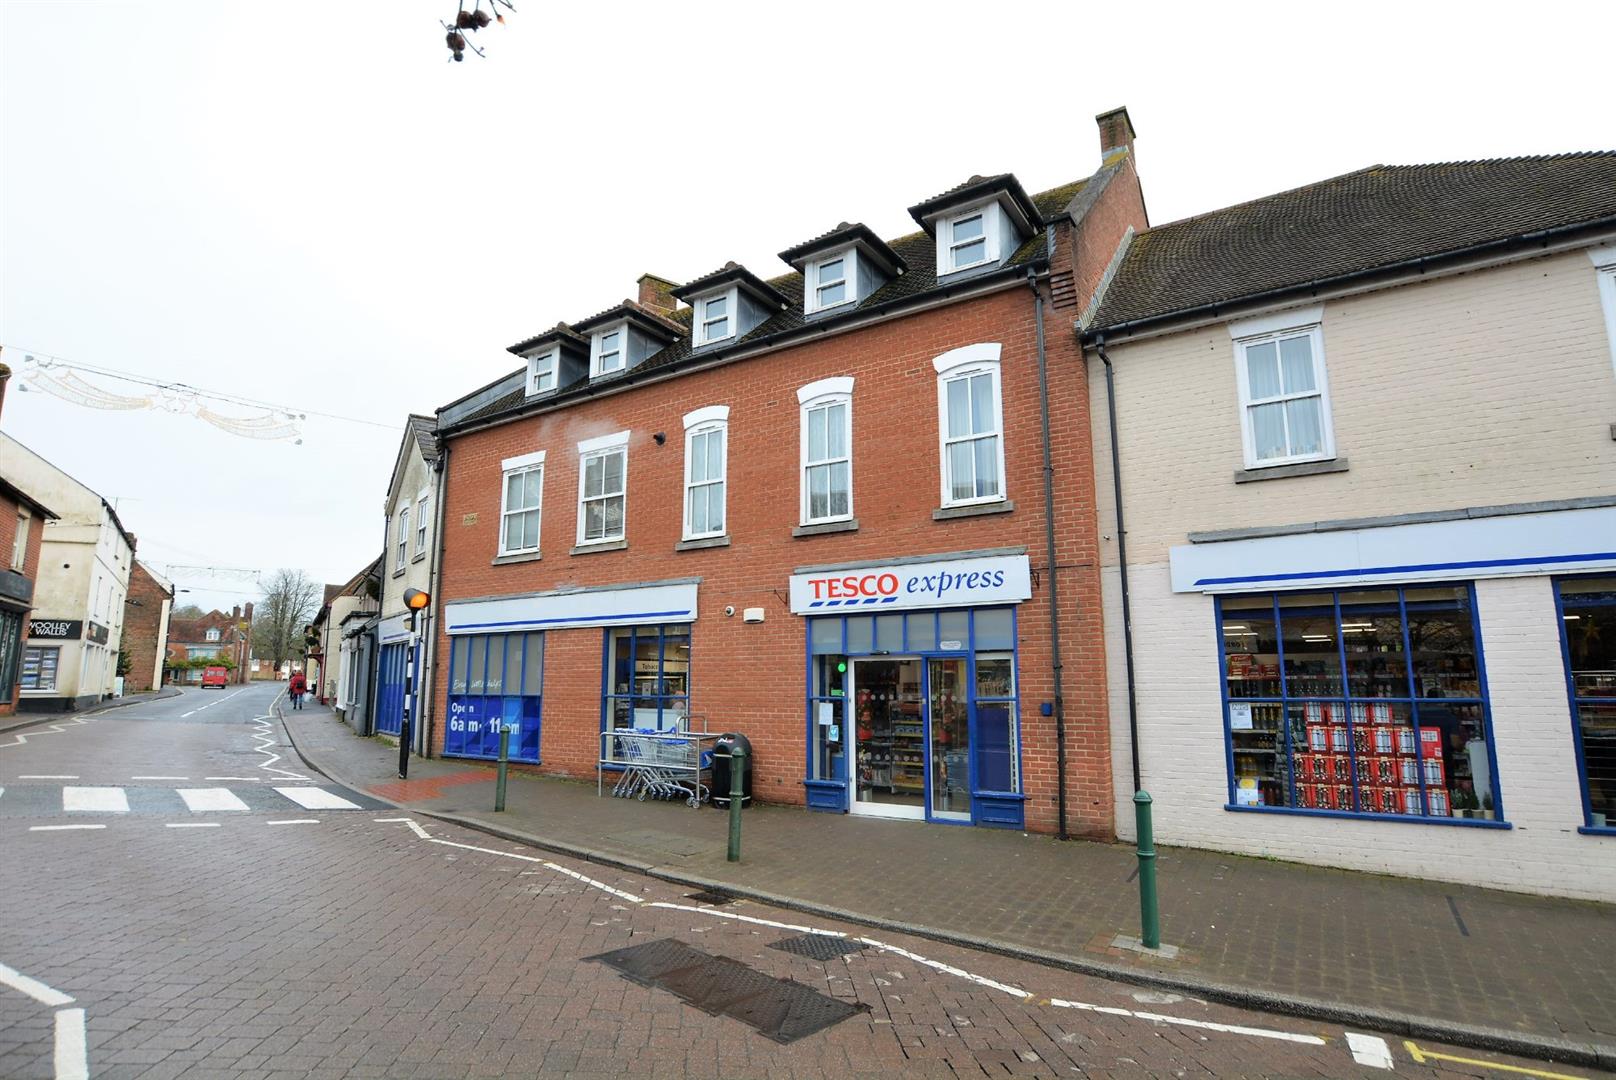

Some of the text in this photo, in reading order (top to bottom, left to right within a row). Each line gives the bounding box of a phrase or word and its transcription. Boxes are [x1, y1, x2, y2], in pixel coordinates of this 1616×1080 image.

[808, 569, 1005, 599] TESCO express
[35, 628, 68, 636] WALLS
